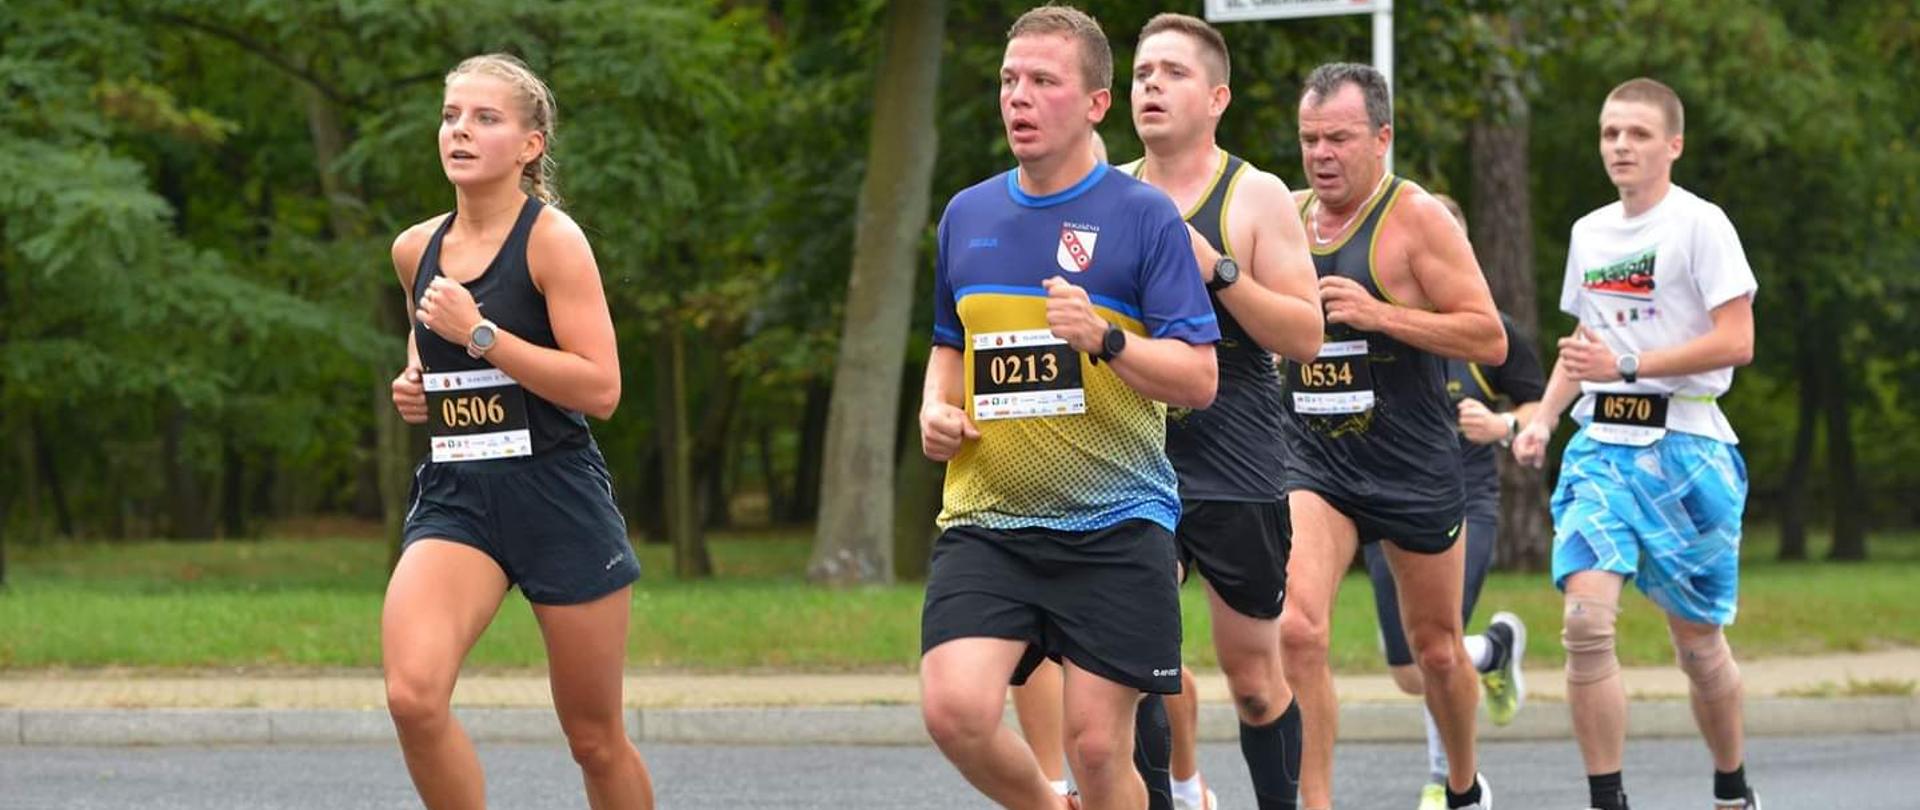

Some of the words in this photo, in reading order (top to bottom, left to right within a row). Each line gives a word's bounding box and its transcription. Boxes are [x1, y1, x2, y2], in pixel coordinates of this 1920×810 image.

[991, 353, 1058, 385] 0213
[1301, 362, 1353, 387] 0534
[443, 394, 504, 428] 0506
[1604, 396, 1651, 420] 0570
